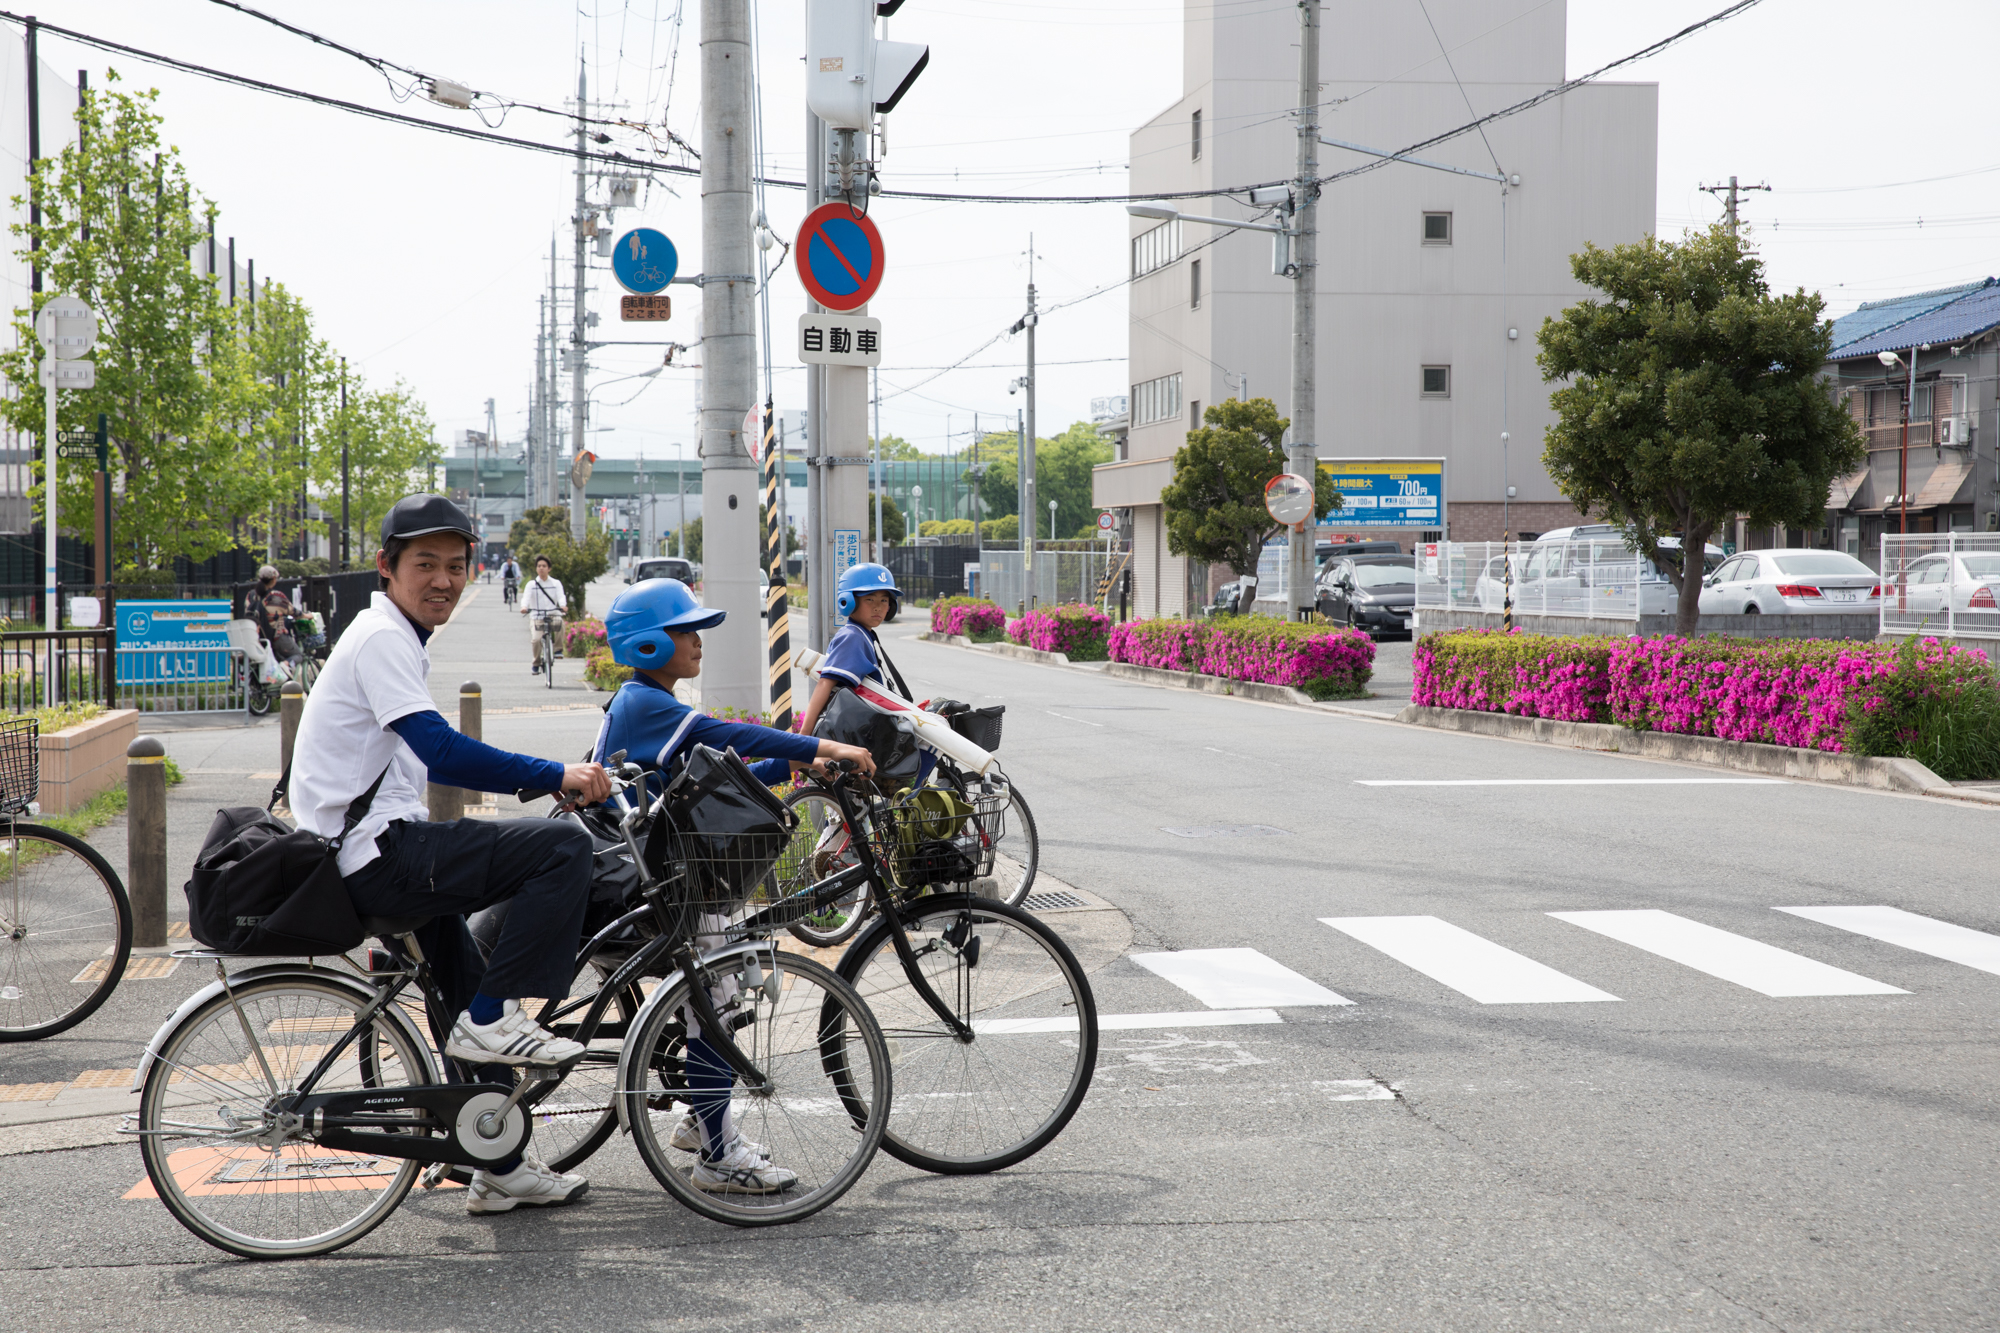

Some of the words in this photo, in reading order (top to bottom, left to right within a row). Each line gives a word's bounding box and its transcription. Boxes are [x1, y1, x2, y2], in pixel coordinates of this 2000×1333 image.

[626, 309, 666, 319] ここまで
[803, 325, 878, 356] 自動車
[1397, 480, 1428, 496] 700円
[1101, 516, 1111, 526] 20
[613, 956, 642, 985] AGENDA
[364, 1097, 404, 1105] AGENDA
